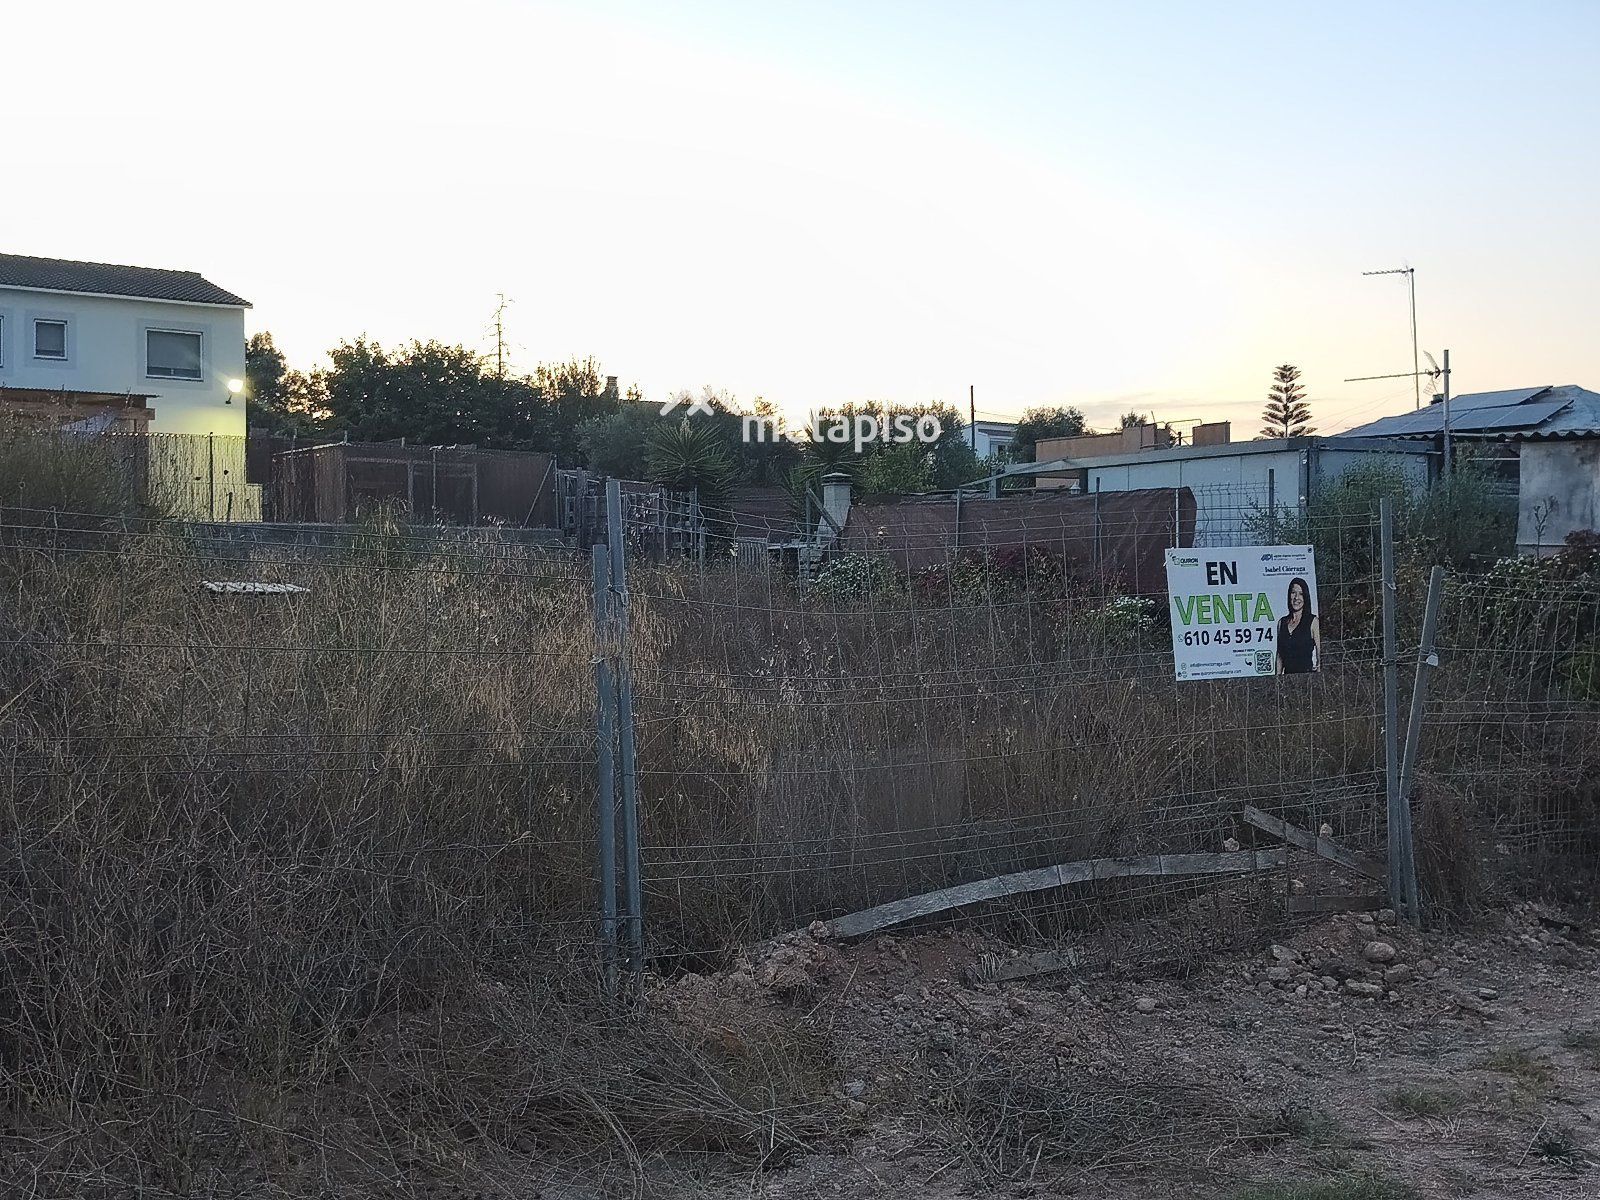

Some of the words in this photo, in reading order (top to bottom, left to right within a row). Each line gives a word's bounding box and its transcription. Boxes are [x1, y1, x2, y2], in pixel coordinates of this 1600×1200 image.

[1206, 561, 1238, 585] EN
[1174, 593, 1275, 625] VENTA
[1184, 630, 1210, 647] 610
[1214, 629, 1231, 645] 45
[1235, 628, 1252, 644] 59
[1256, 627, 1273, 643] 74
